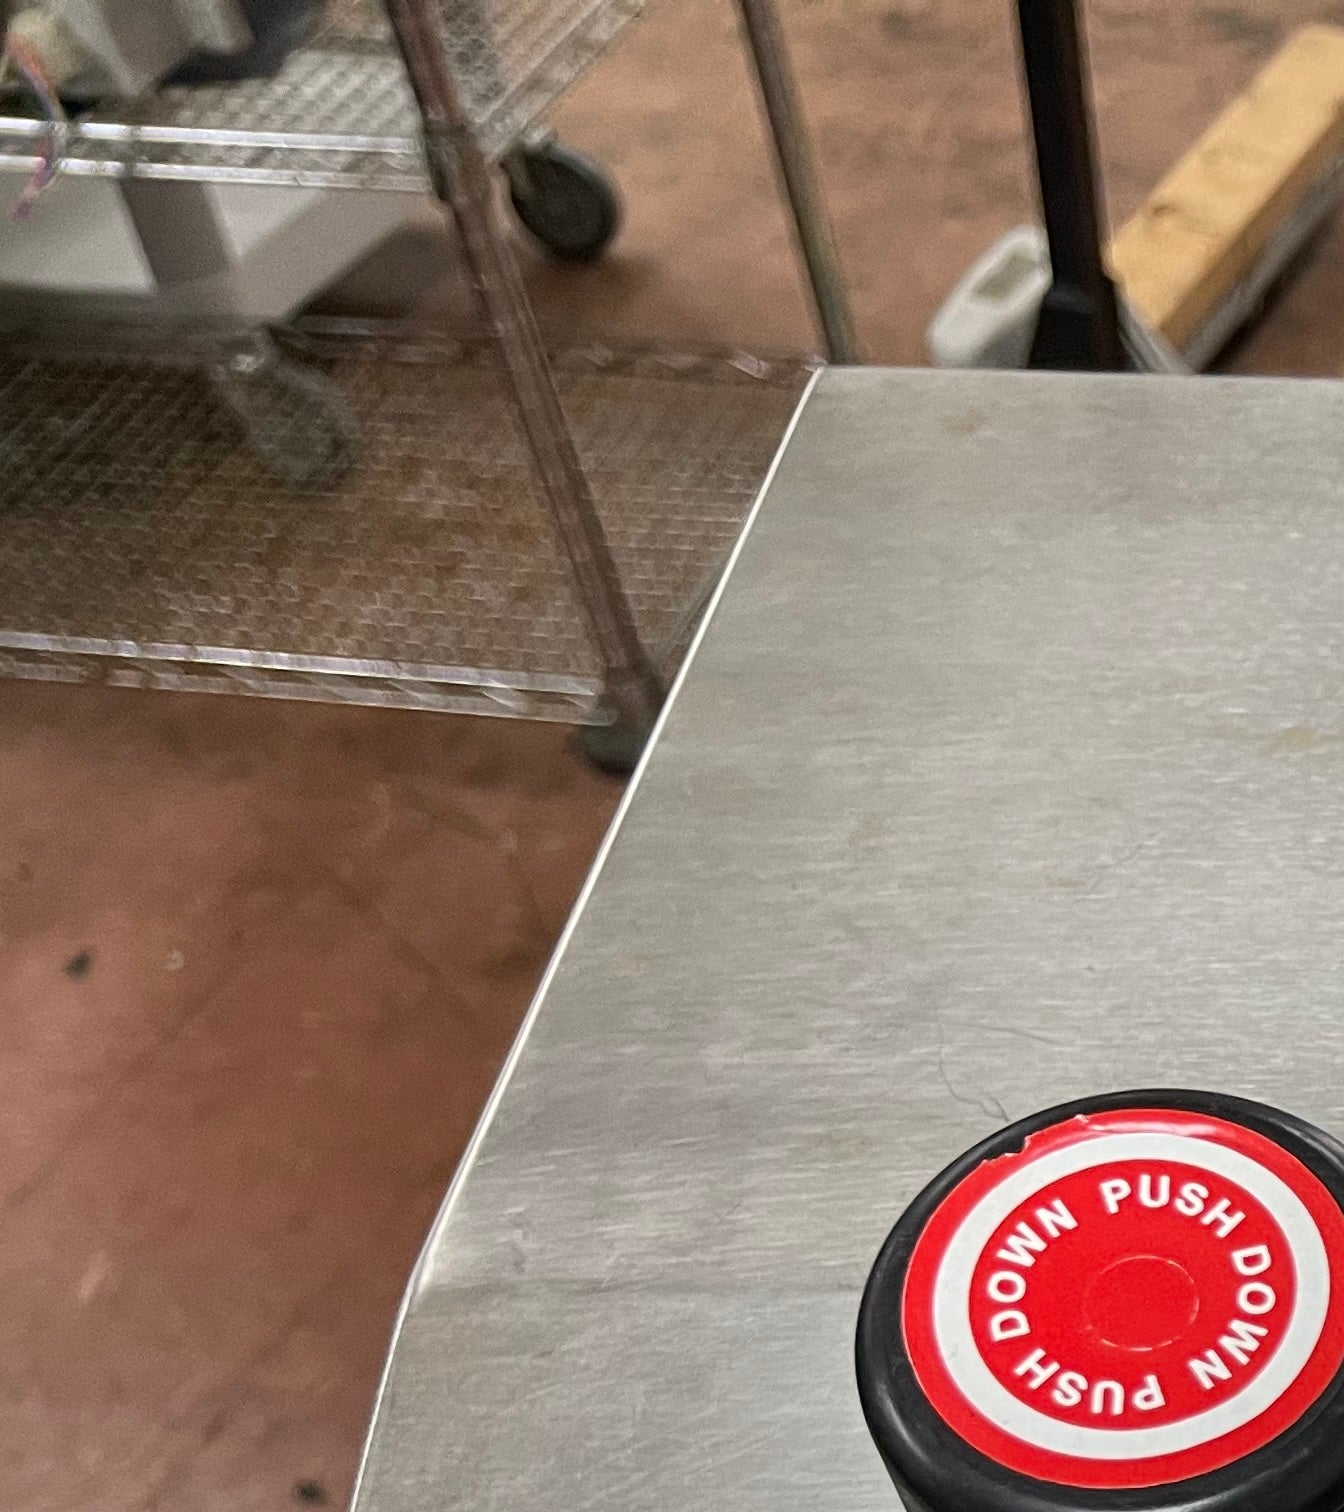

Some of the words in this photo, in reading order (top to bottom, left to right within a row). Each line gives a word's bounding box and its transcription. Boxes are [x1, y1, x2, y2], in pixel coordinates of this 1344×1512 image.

[1099, 1174, 1246, 1239] PUSH
[986, 1199, 1078, 1342] DOWN
[1187, 1243, 1277, 1390] DOWN
[1014, 1348, 1166, 1415] PUSH
